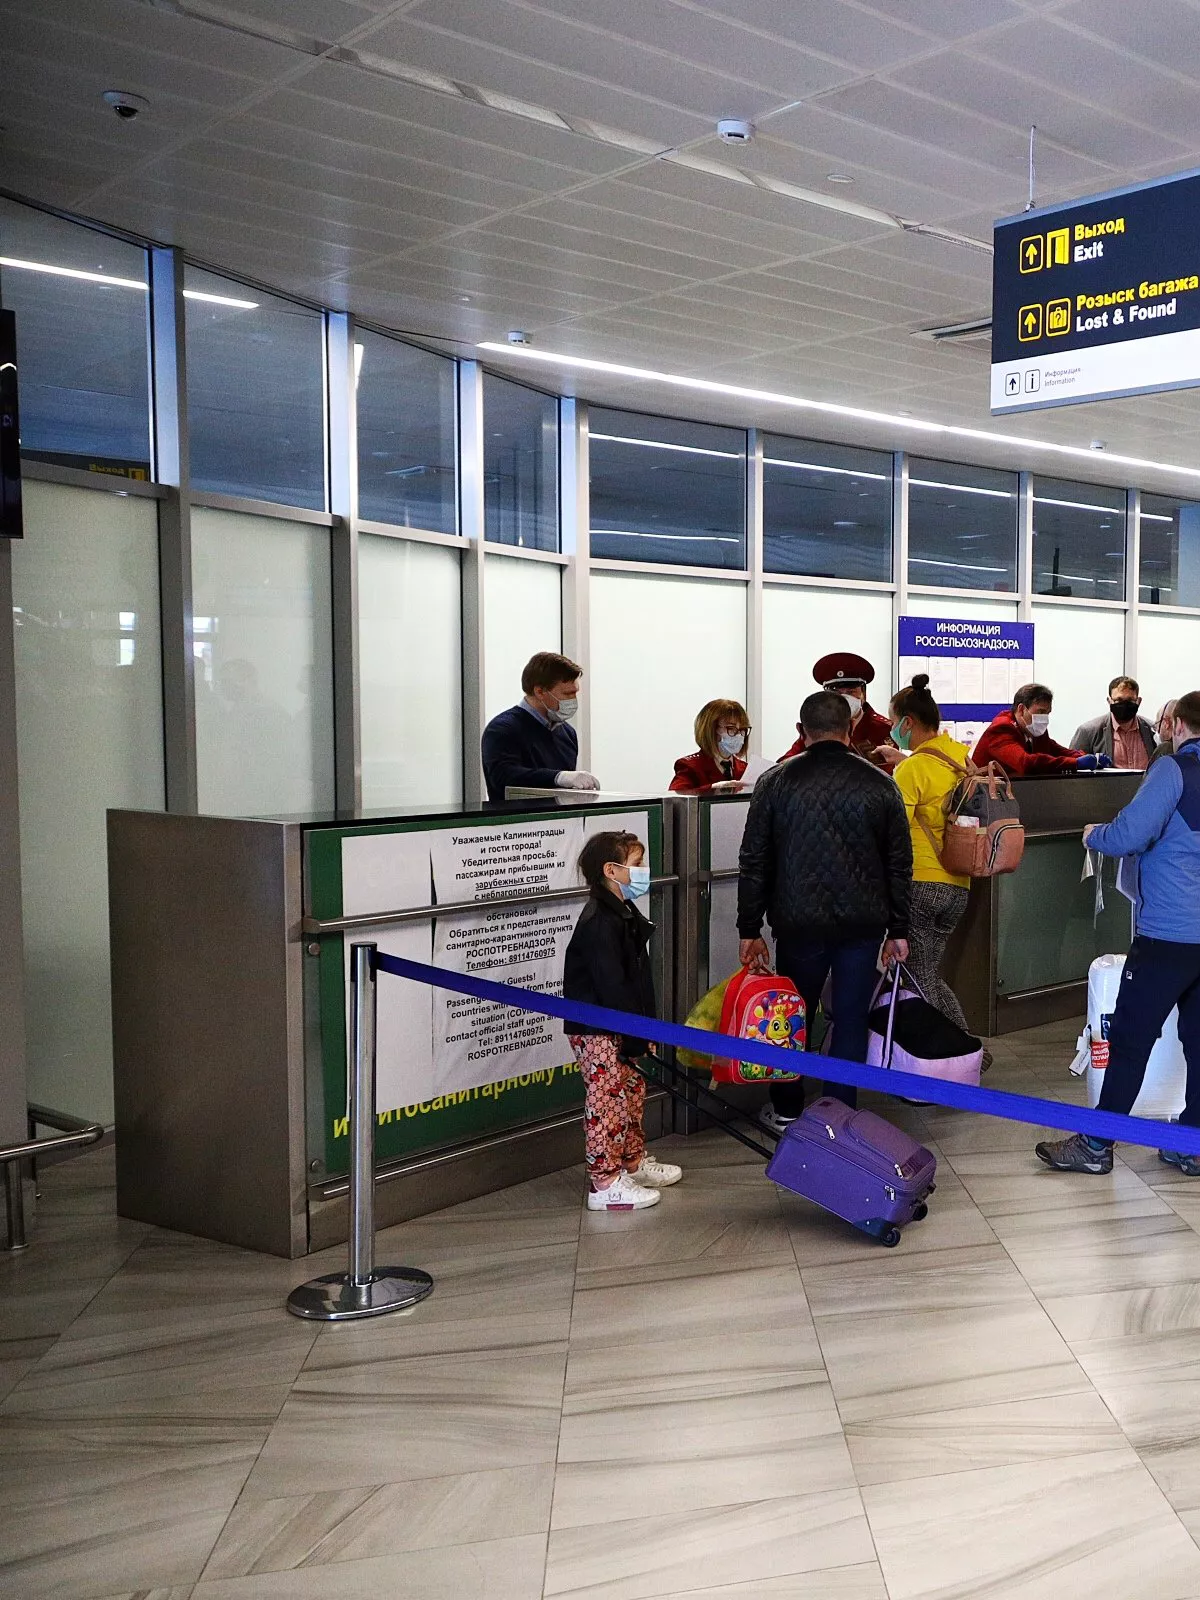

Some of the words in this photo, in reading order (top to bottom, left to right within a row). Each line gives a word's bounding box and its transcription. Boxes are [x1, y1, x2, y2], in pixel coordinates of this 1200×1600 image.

[1074, 217, 1125, 241] Выход
[1073, 240, 1104, 262] Exit
[1076, 288, 1135, 311] Розыск
[1138, 275, 1199, 299] багажа
[1076, 314, 1109, 332] Lost
[1112, 311, 1124, 325] &
[1129, 298, 1177, 322] Found
[1044, 377, 1076, 387] Information
[936, 622, 1001, 637] ИНФОРМАЦИЯ
[915, 635, 1020, 651] РОССЕЛЬХОЗНАДЗОРА
[452, 834, 501, 845] Уважаемые
[503, 828, 565, 841] Калининградцы
[488, 845, 510, 854] гости
[511, 840, 542, 852] города!
[461, 856, 521, 868] Убедительная
[522, 851, 558, 862] просьба:
[455, 868, 506, 880] пассажирам
[508, 863, 555, 874] прибывшим
[475, 877, 524, 889] зарубежных
[526, 874, 548, 884] стран
[486, 907, 538, 921] обстановкой
[449, 924, 499, 939] Обратиться
[507, 914, 571, 930] представителям
[446, 929, 547, 951] санитарно-карантинного
[548, 924, 573, 935] пункта
[466, 937, 556, 958] РОСПОТРЕБНАДЗОРА
[466, 957, 507, 970] Телефон:
[508, 948, 556, 963] 89114760975
[507, 973, 536, 985] Guests!
[545, 978, 563, 989] forei
[451, 1005, 491, 1018] countries
[445, 1031, 478, 1043] contact
[478, 1025, 505, 1036] official
[506, 1021, 524, 1031] staff
[526, 1015, 545, 1026] upon
[471, 1015, 505, 1027] situation
[478, 1038, 493, 1048] Tel:
[494, 1025, 544, 1044] 89114760975
[467, 1034, 553, 1061] ROSPOTREBNADZOR
